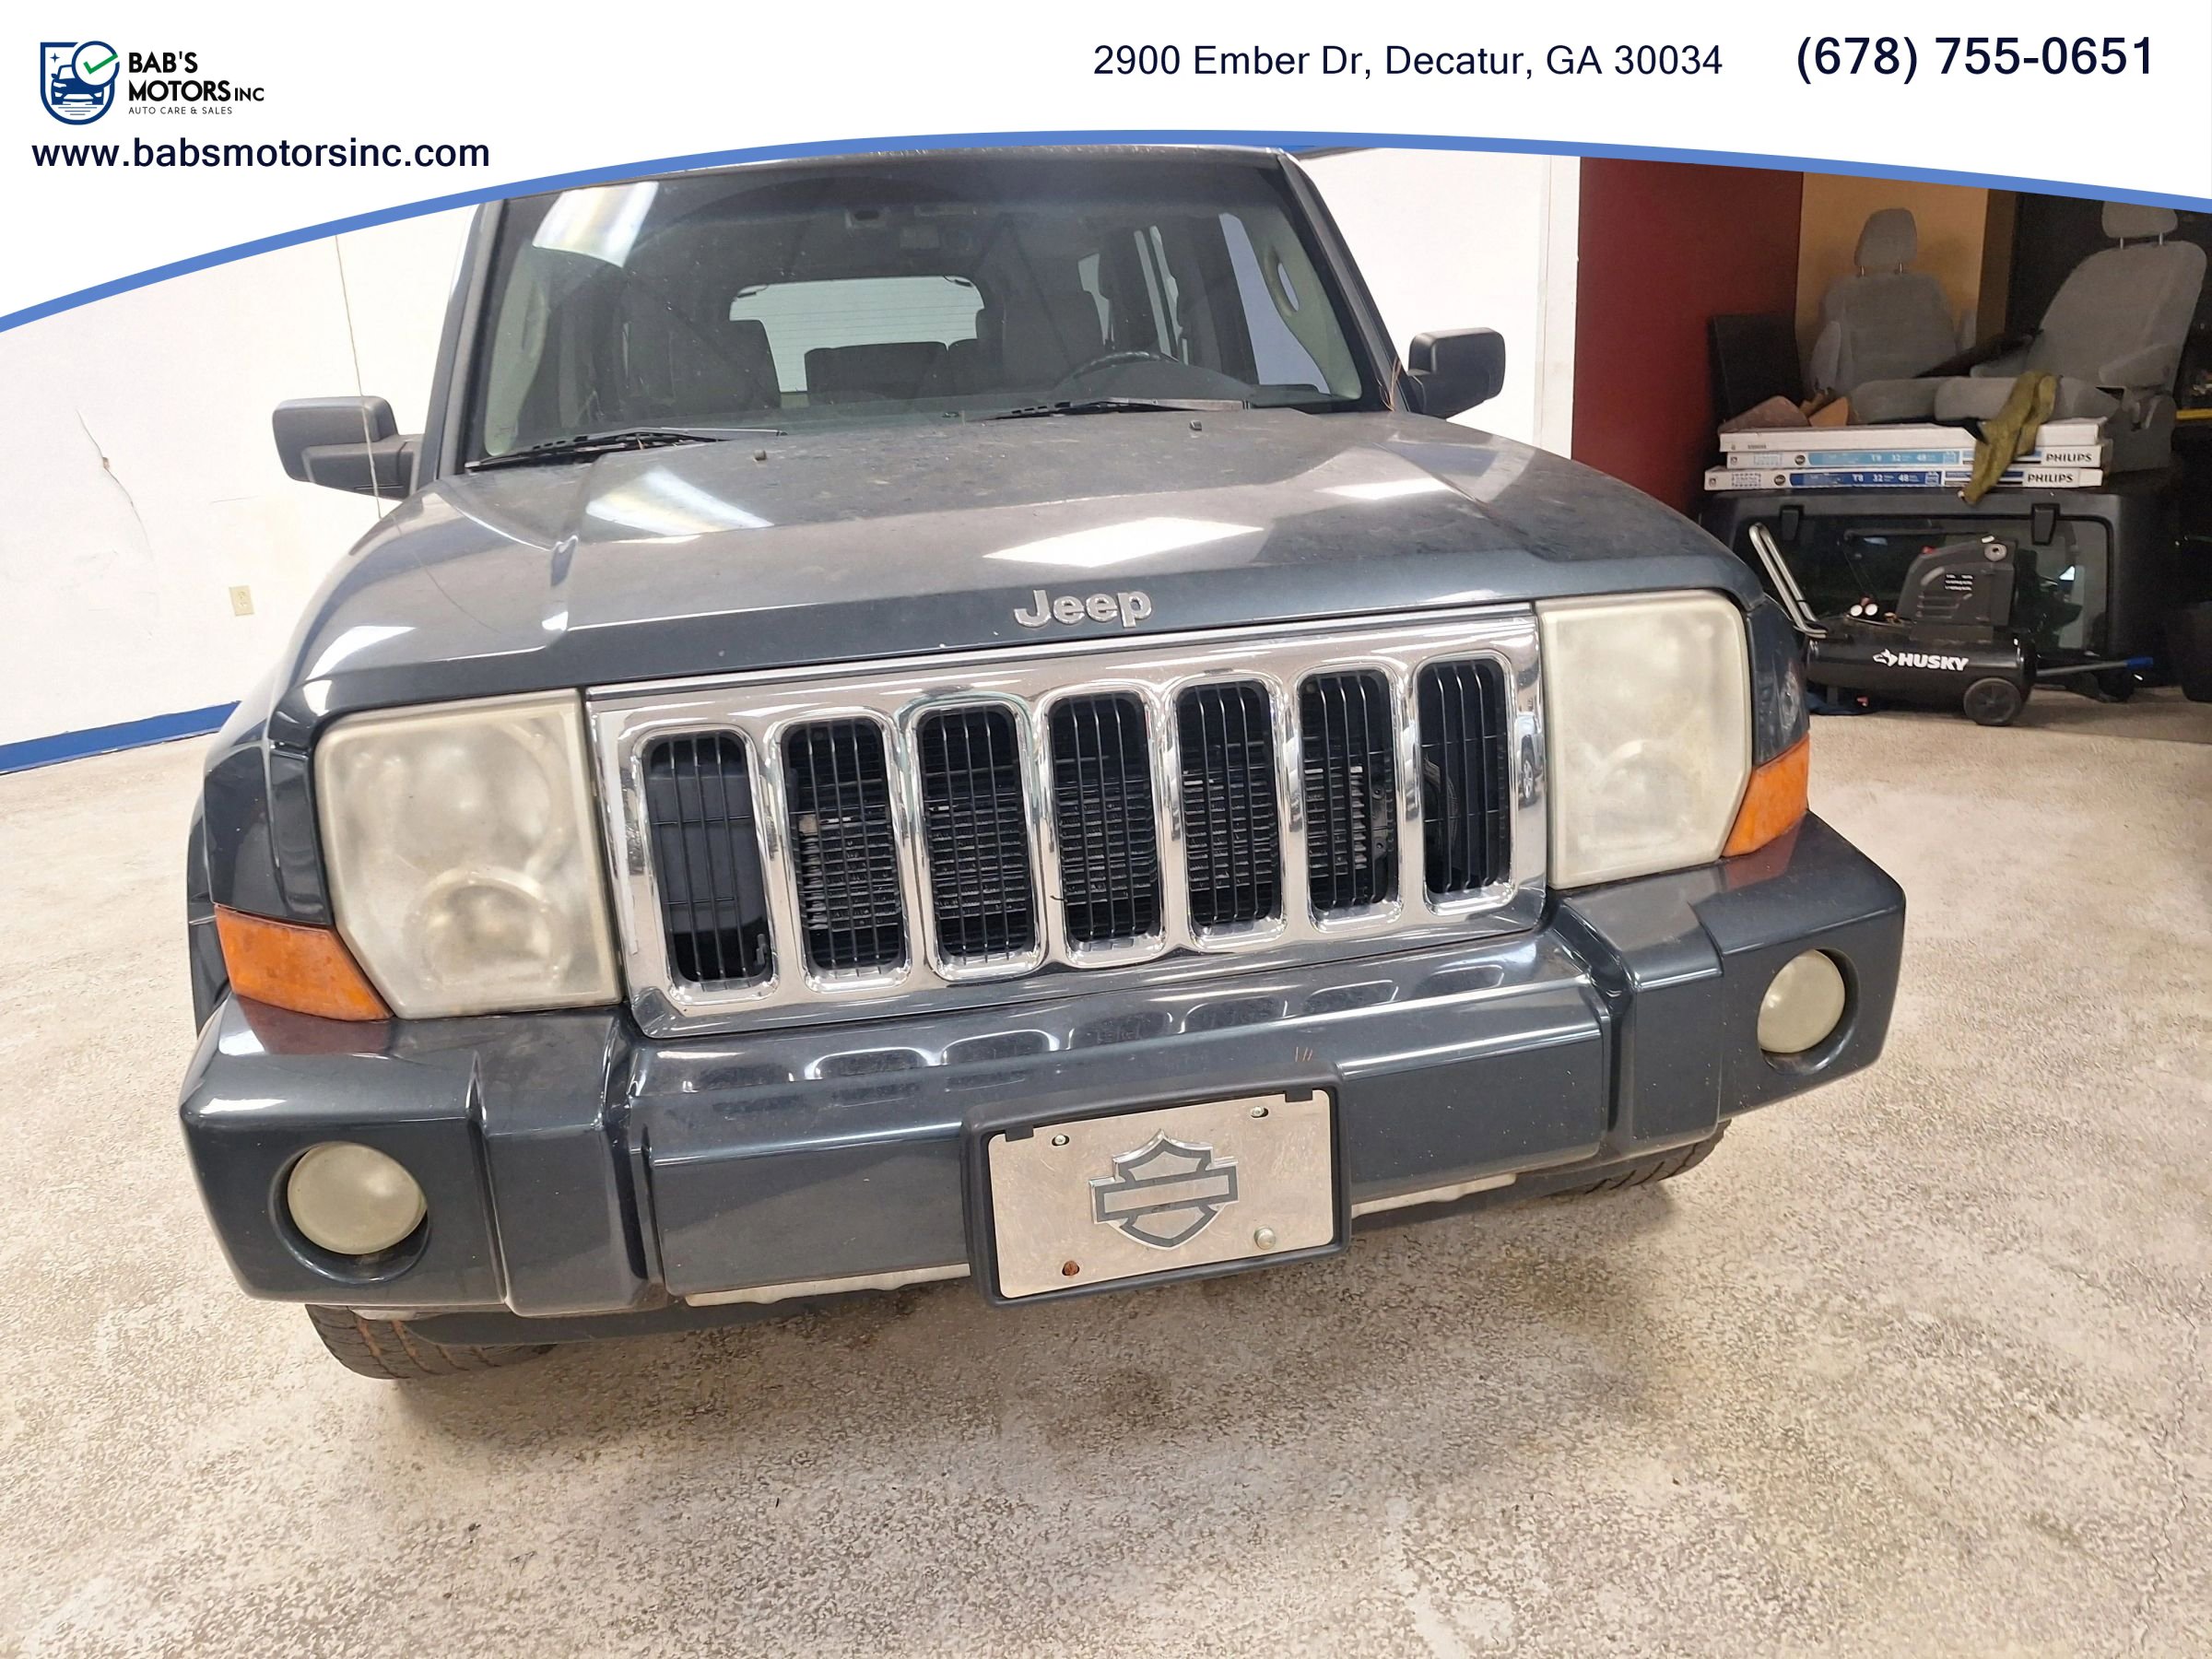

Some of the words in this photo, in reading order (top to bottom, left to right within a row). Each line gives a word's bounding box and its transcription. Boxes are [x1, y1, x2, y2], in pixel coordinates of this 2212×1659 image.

[2045, 453, 2093, 463] PHILIPS
[2028, 473, 2074, 484] PHILIPS
[1014, 589, 1152, 629] Jeep
[1898, 652, 1969, 671] HUSKY
